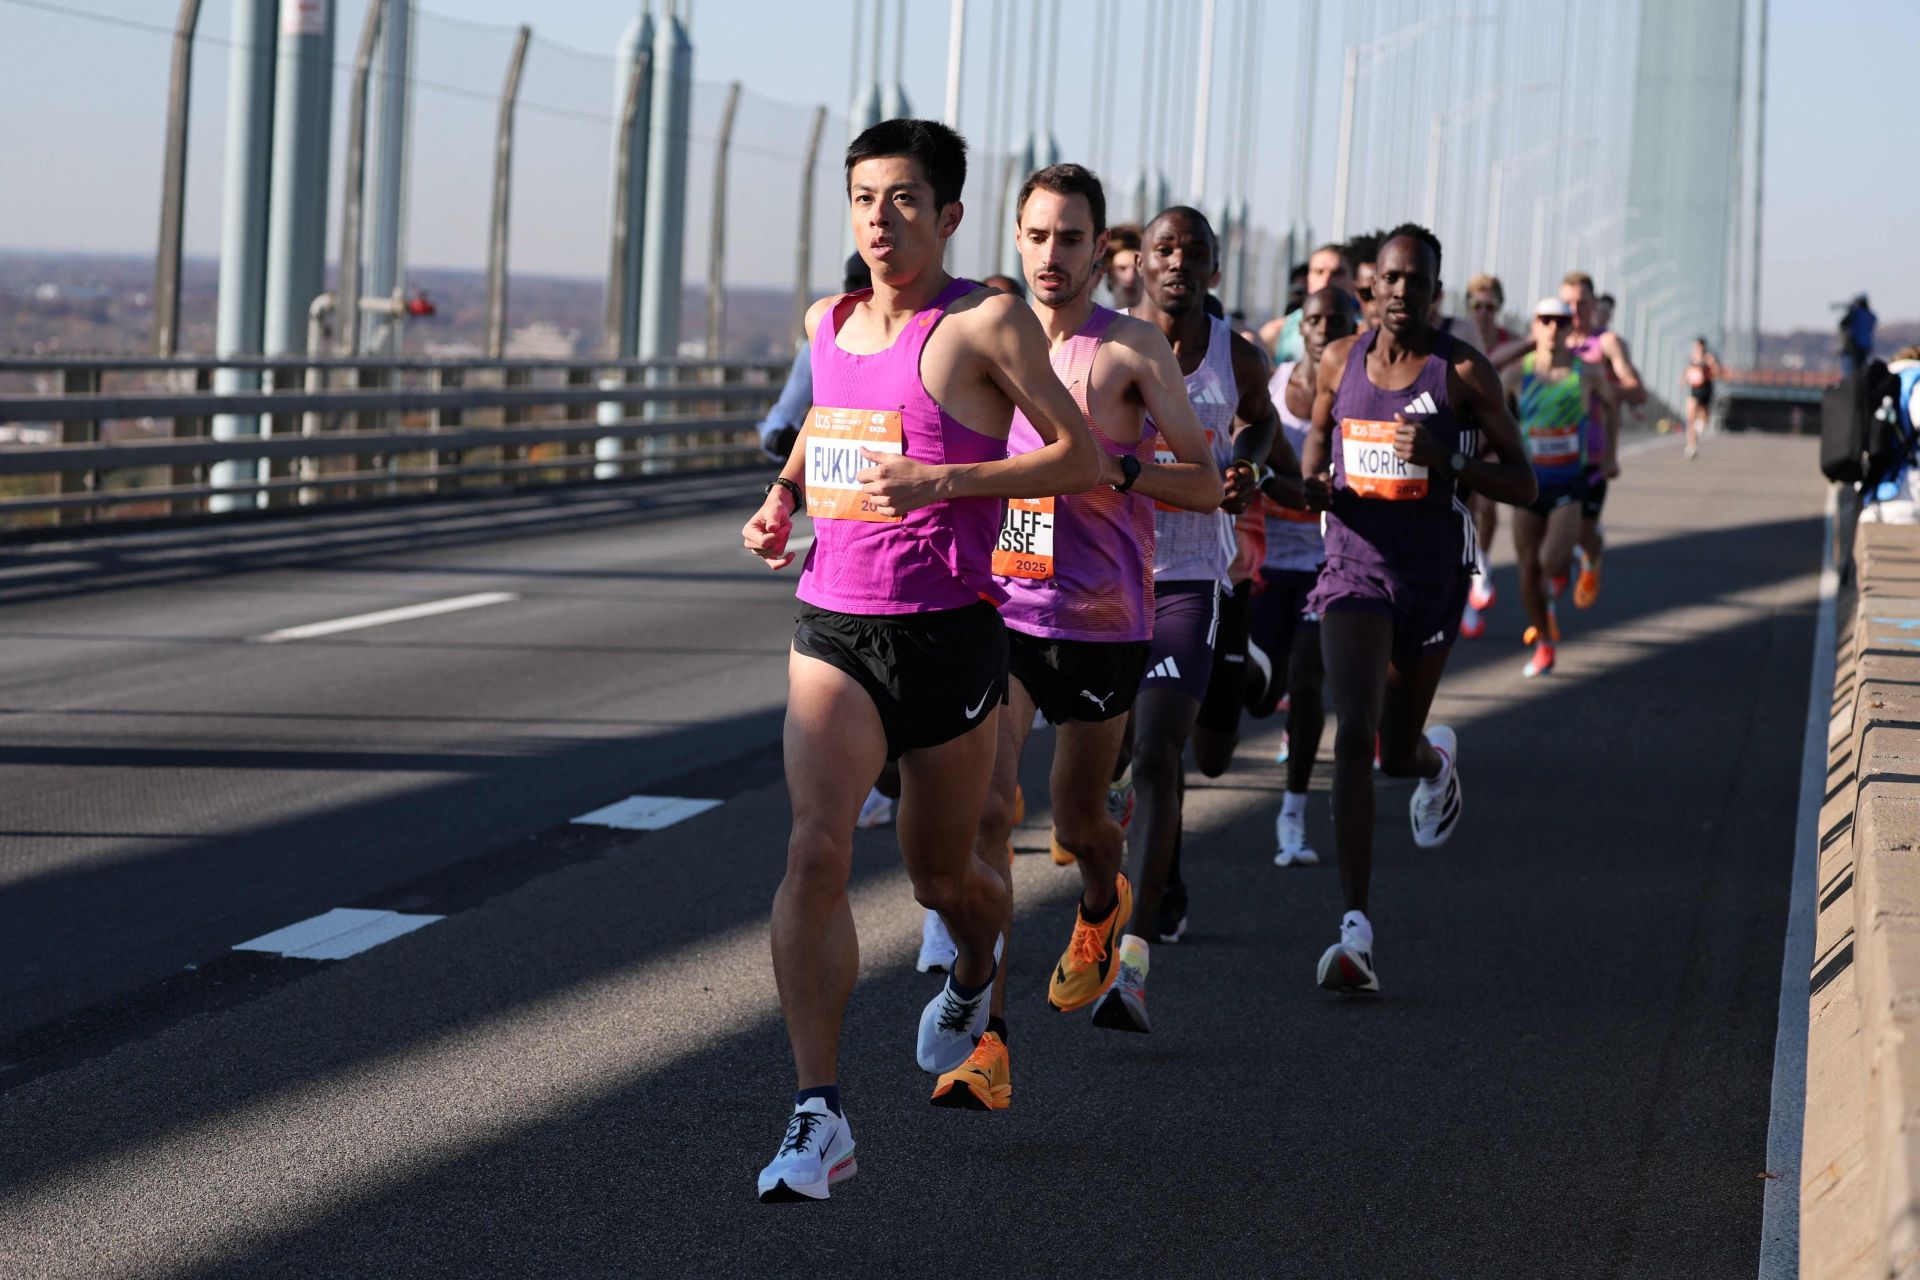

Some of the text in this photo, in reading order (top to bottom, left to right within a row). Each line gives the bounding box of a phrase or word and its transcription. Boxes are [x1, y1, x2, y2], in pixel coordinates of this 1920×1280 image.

[814, 446, 880, 485] FUKU
[1359, 448, 1407, 476] KORIR
[1016, 560, 1046, 572] 2025
